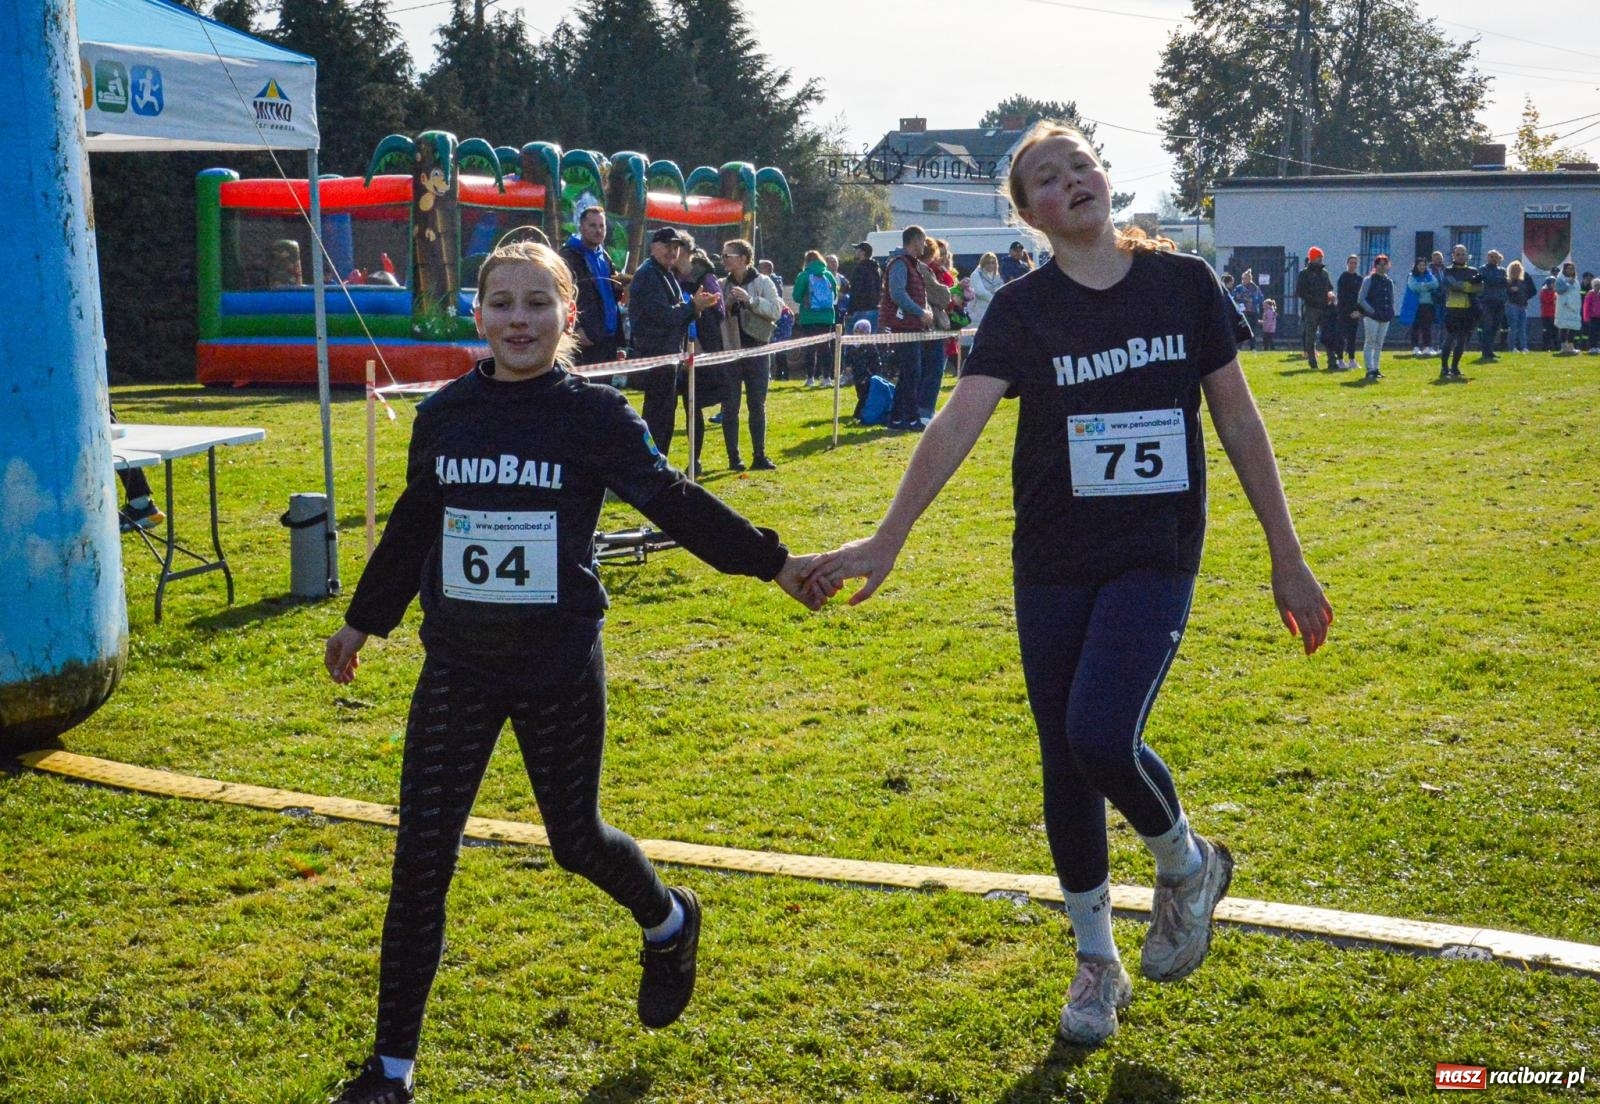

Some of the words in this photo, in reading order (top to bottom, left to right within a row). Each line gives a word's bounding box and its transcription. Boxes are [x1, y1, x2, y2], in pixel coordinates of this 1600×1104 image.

[253, 100, 292, 122] MITKO
[1052, 334, 1187, 386] HANDBALL
[1110, 418, 1181, 430] www.personalbest.pl
[1095, 440, 1164, 481] 75
[475, 522, 552, 532] www.personalbest.pl
[462, 543, 531, 587] 64
